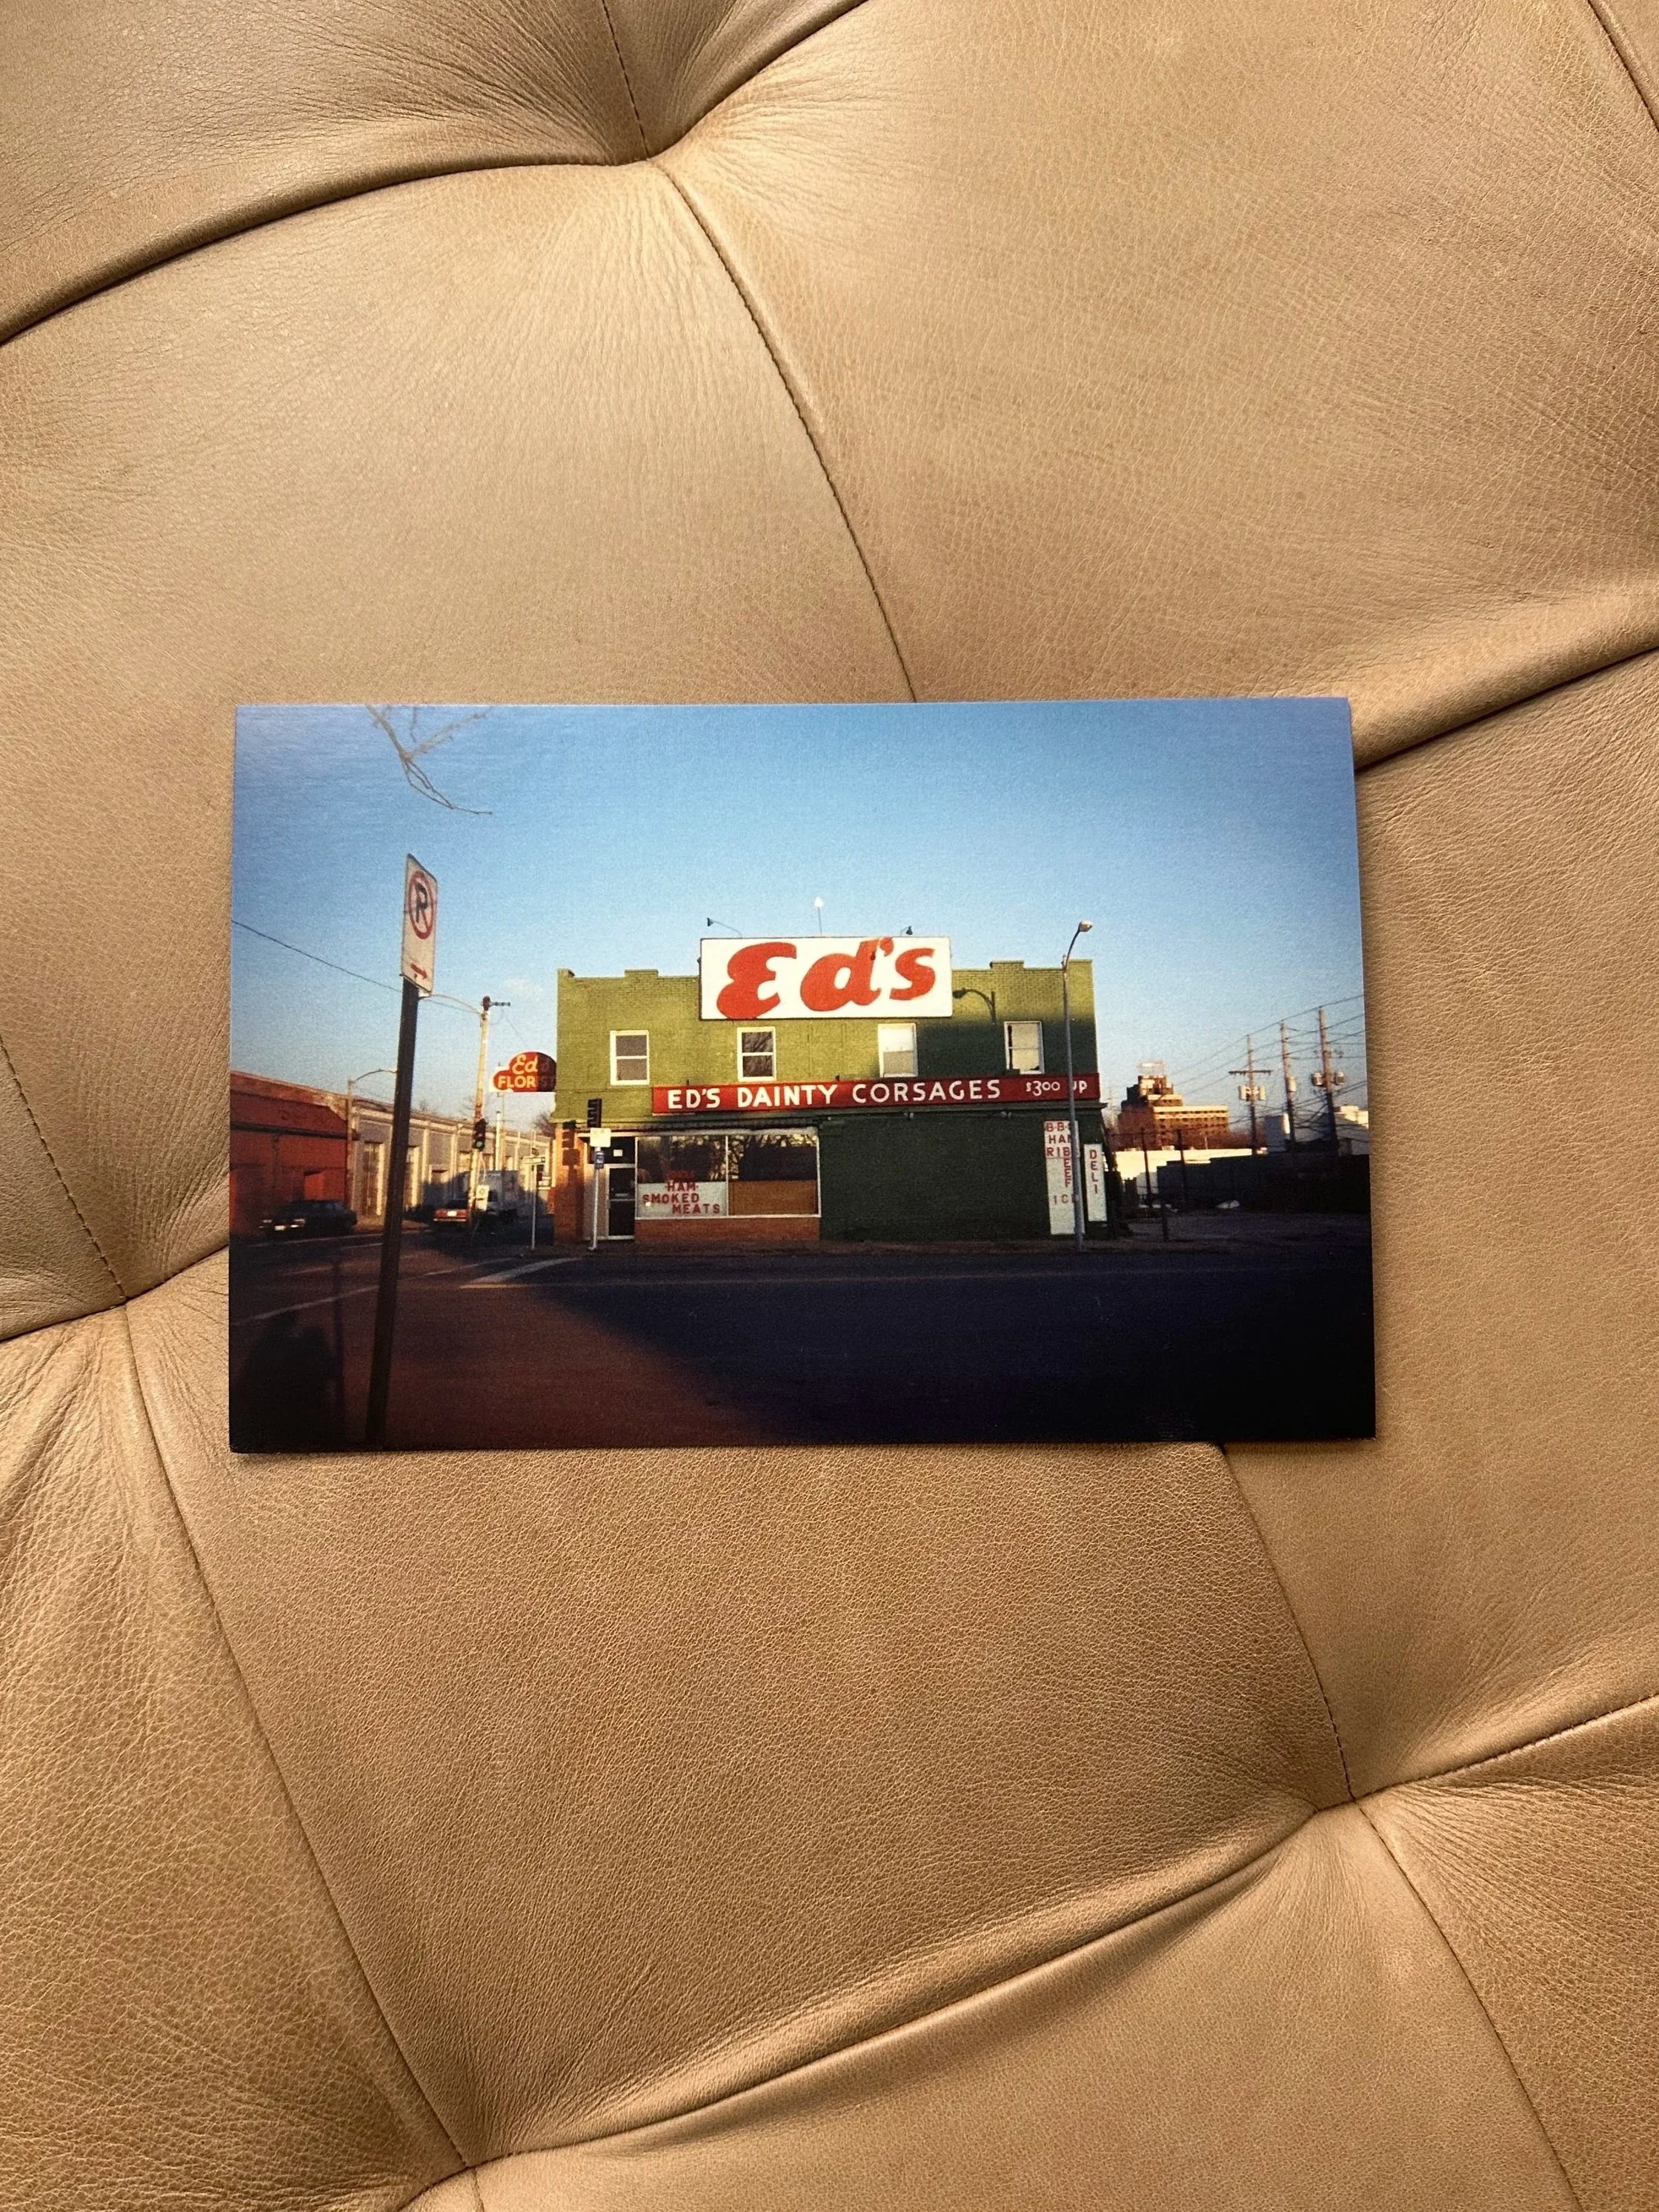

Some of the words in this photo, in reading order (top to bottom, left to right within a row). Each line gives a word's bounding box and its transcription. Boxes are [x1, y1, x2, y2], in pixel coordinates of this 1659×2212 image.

[717, 936, 935, 1019] Ed's
[668, 1087, 720, 1109] ED'S
[737, 1084, 837, 1108] DAINTY
[852, 1079, 1000, 1103] CORSAGES
[1046, 1147, 1070, 1156] RIB
[1090, 1149, 1098, 1193] DELI
[642, 1193, 699, 1204] SMOKED
[672, 1204, 720, 1214] MEATS
